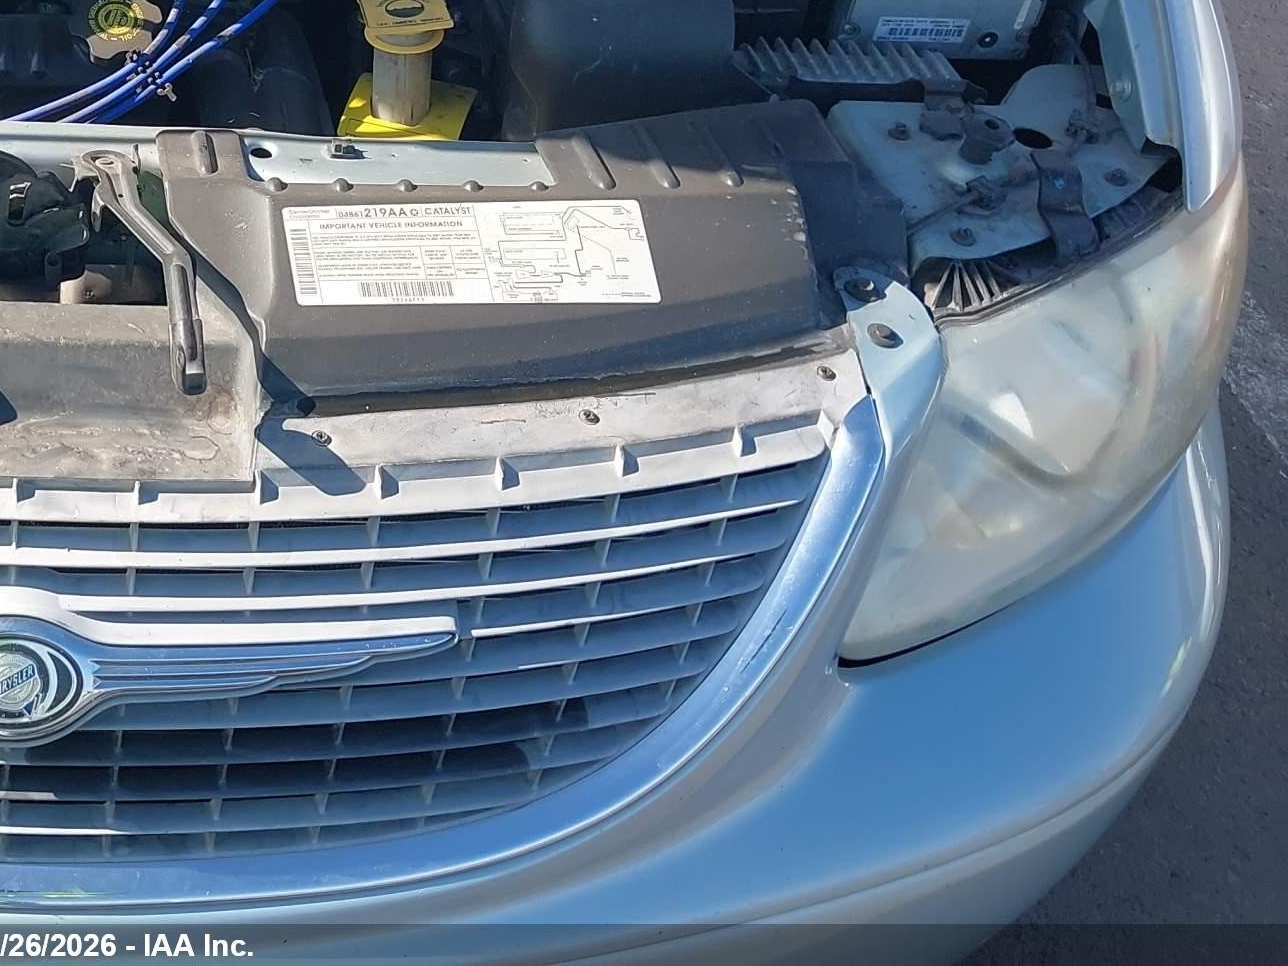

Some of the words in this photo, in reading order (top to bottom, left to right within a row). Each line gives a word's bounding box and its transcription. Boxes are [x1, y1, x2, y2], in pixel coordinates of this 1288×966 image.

[423, 206, 472, 216] CATALYST
[318, 222, 367, 230] IMPORTANT
[368, 221, 403, 229] VEHICLE
[404, 220, 463, 229] INFORMATION
